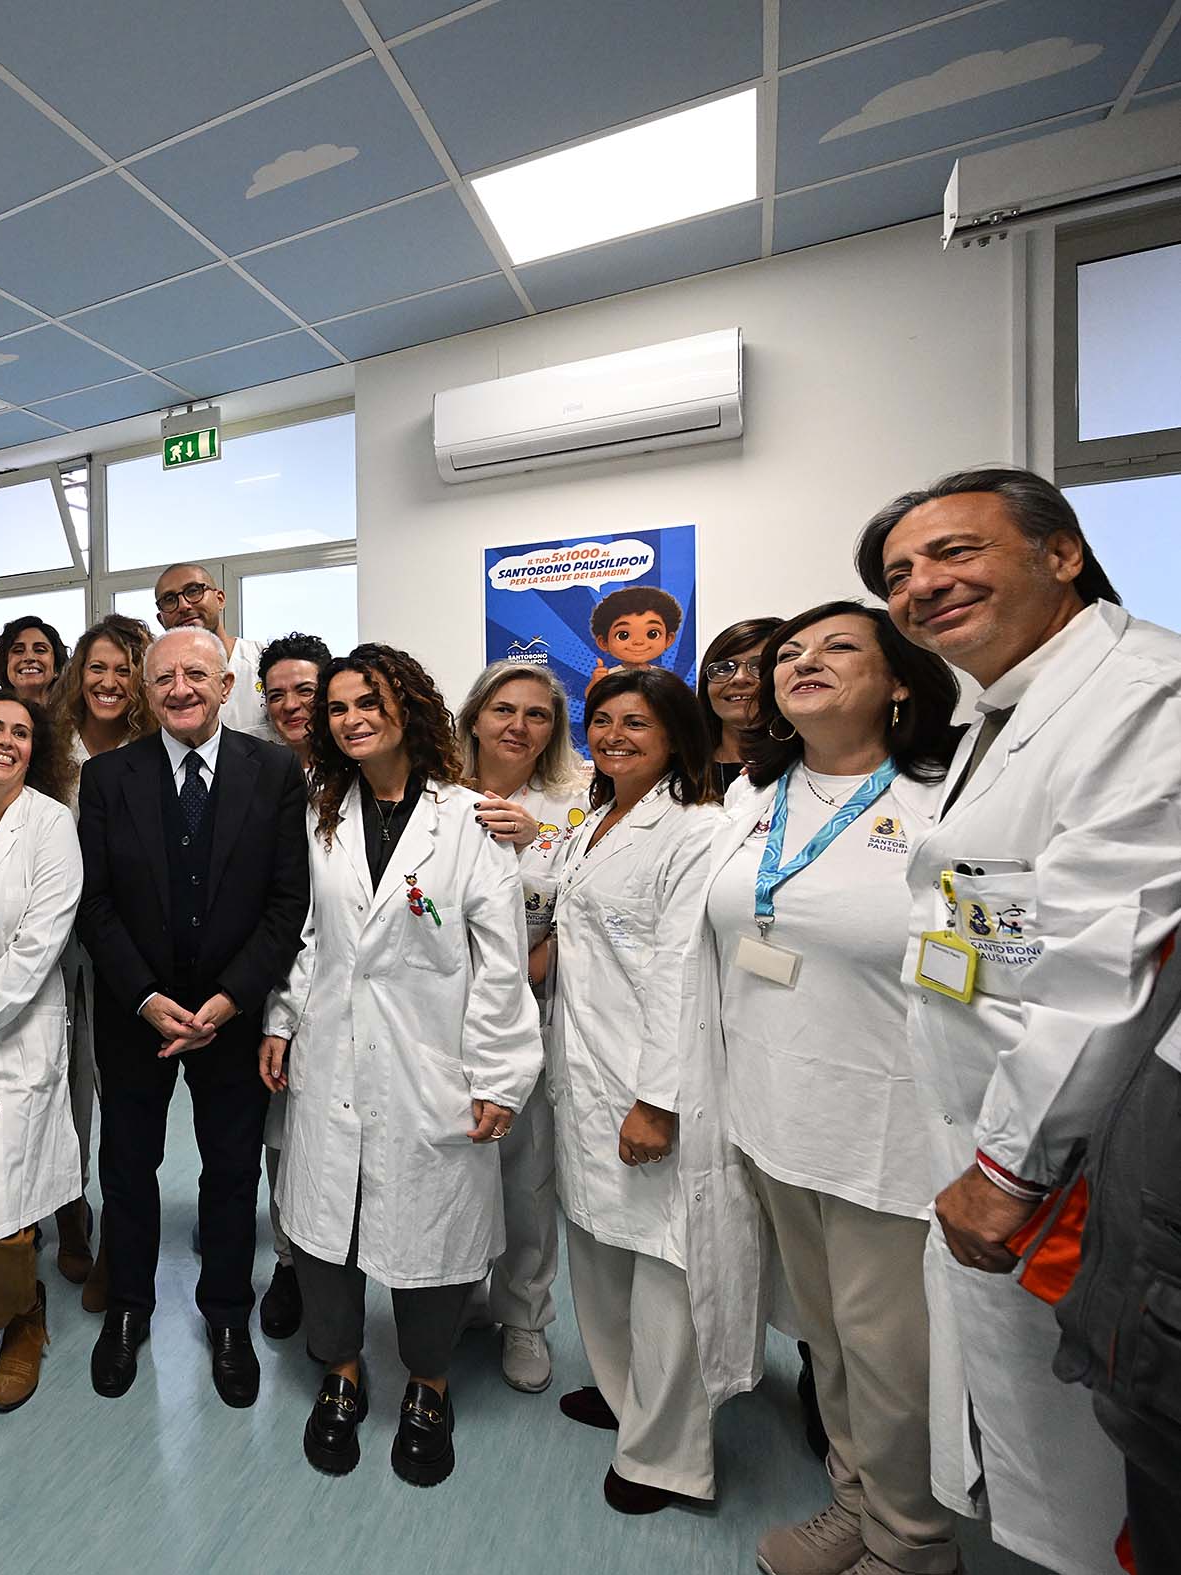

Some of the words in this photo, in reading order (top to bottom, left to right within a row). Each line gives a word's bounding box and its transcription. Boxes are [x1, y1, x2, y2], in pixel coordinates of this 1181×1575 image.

[550, 548, 600, 563] 5x1000
[497, 563, 572, 579] SANTOBONO
[573, 554, 649, 572] PAUSILIPON
[509, 578, 527, 586] PER
[539, 573, 572, 583] SALUTE
[573, 572, 589, 580] DEI
[589, 568, 630, 578] BAMBINI
